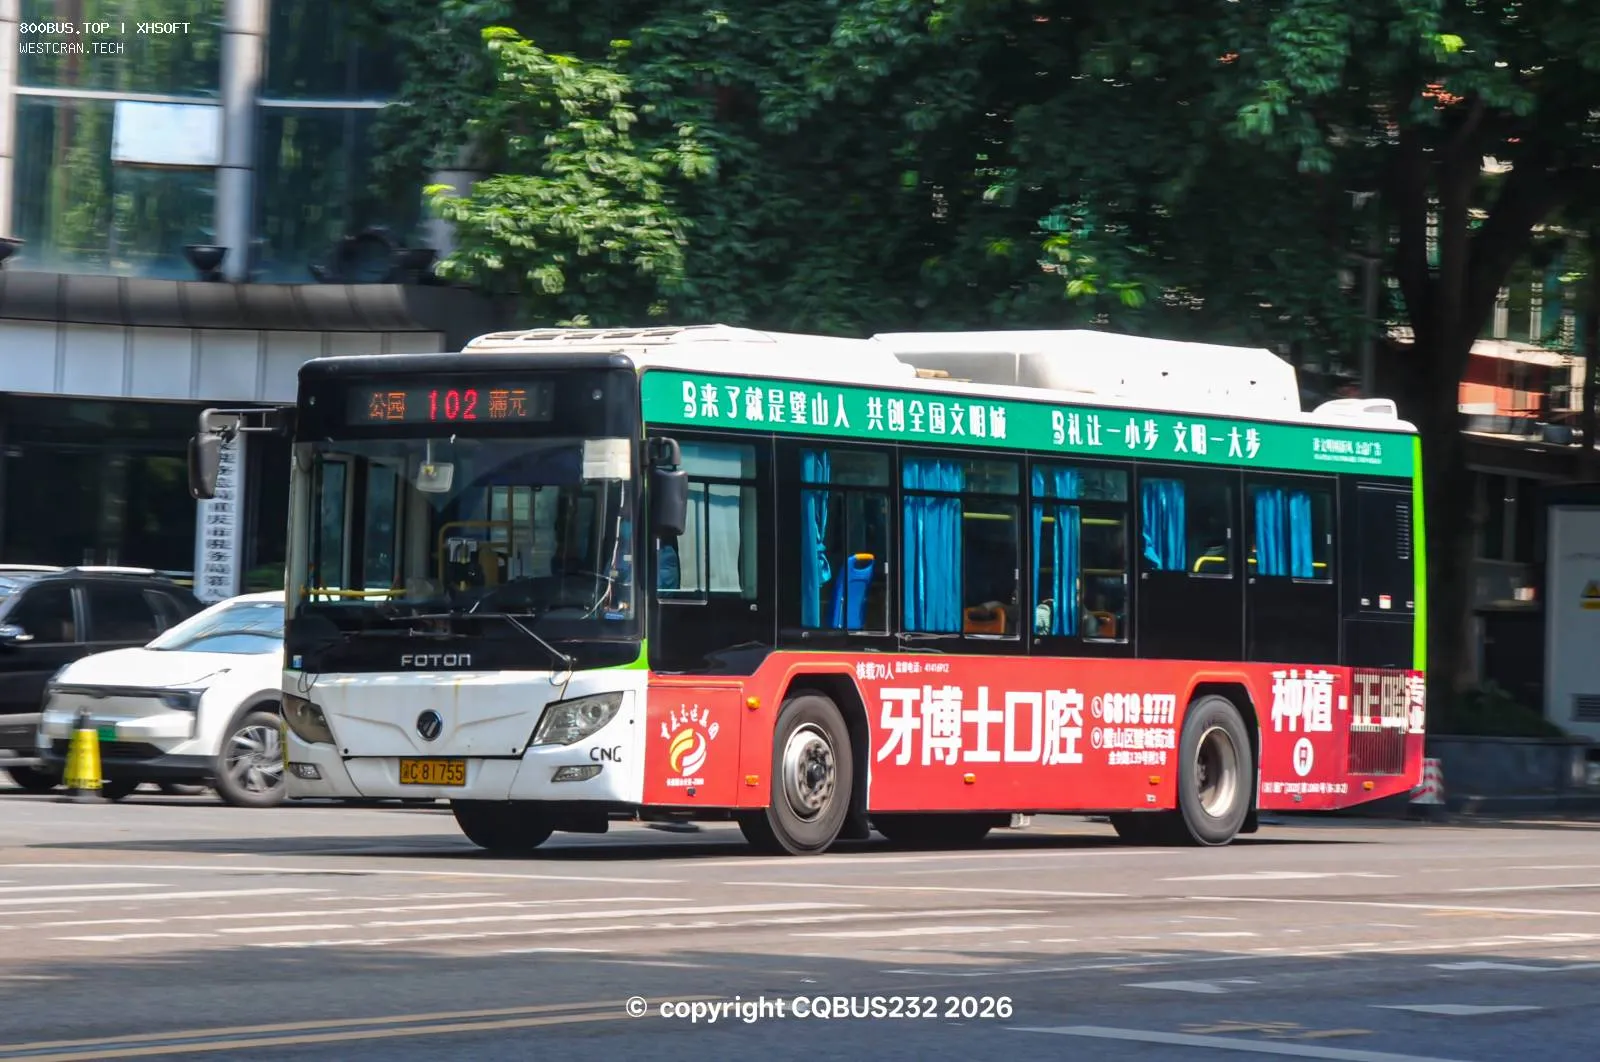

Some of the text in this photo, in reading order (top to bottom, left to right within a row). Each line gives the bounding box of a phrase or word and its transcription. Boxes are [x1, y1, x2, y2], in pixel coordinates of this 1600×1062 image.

[368, 391, 406, 420] 公园
[429, 389, 479, 421] 102
[866, 396, 1007, 440] 共创全国文明城
[1173, 421, 1261, 459] 文明一大步
[401, 654, 471, 667] FOTON
[856, 661, 895, 680] 核载70人
[877, 684, 1084, 766] 牙博士口腔
[590, 746, 622, 762] CNG
